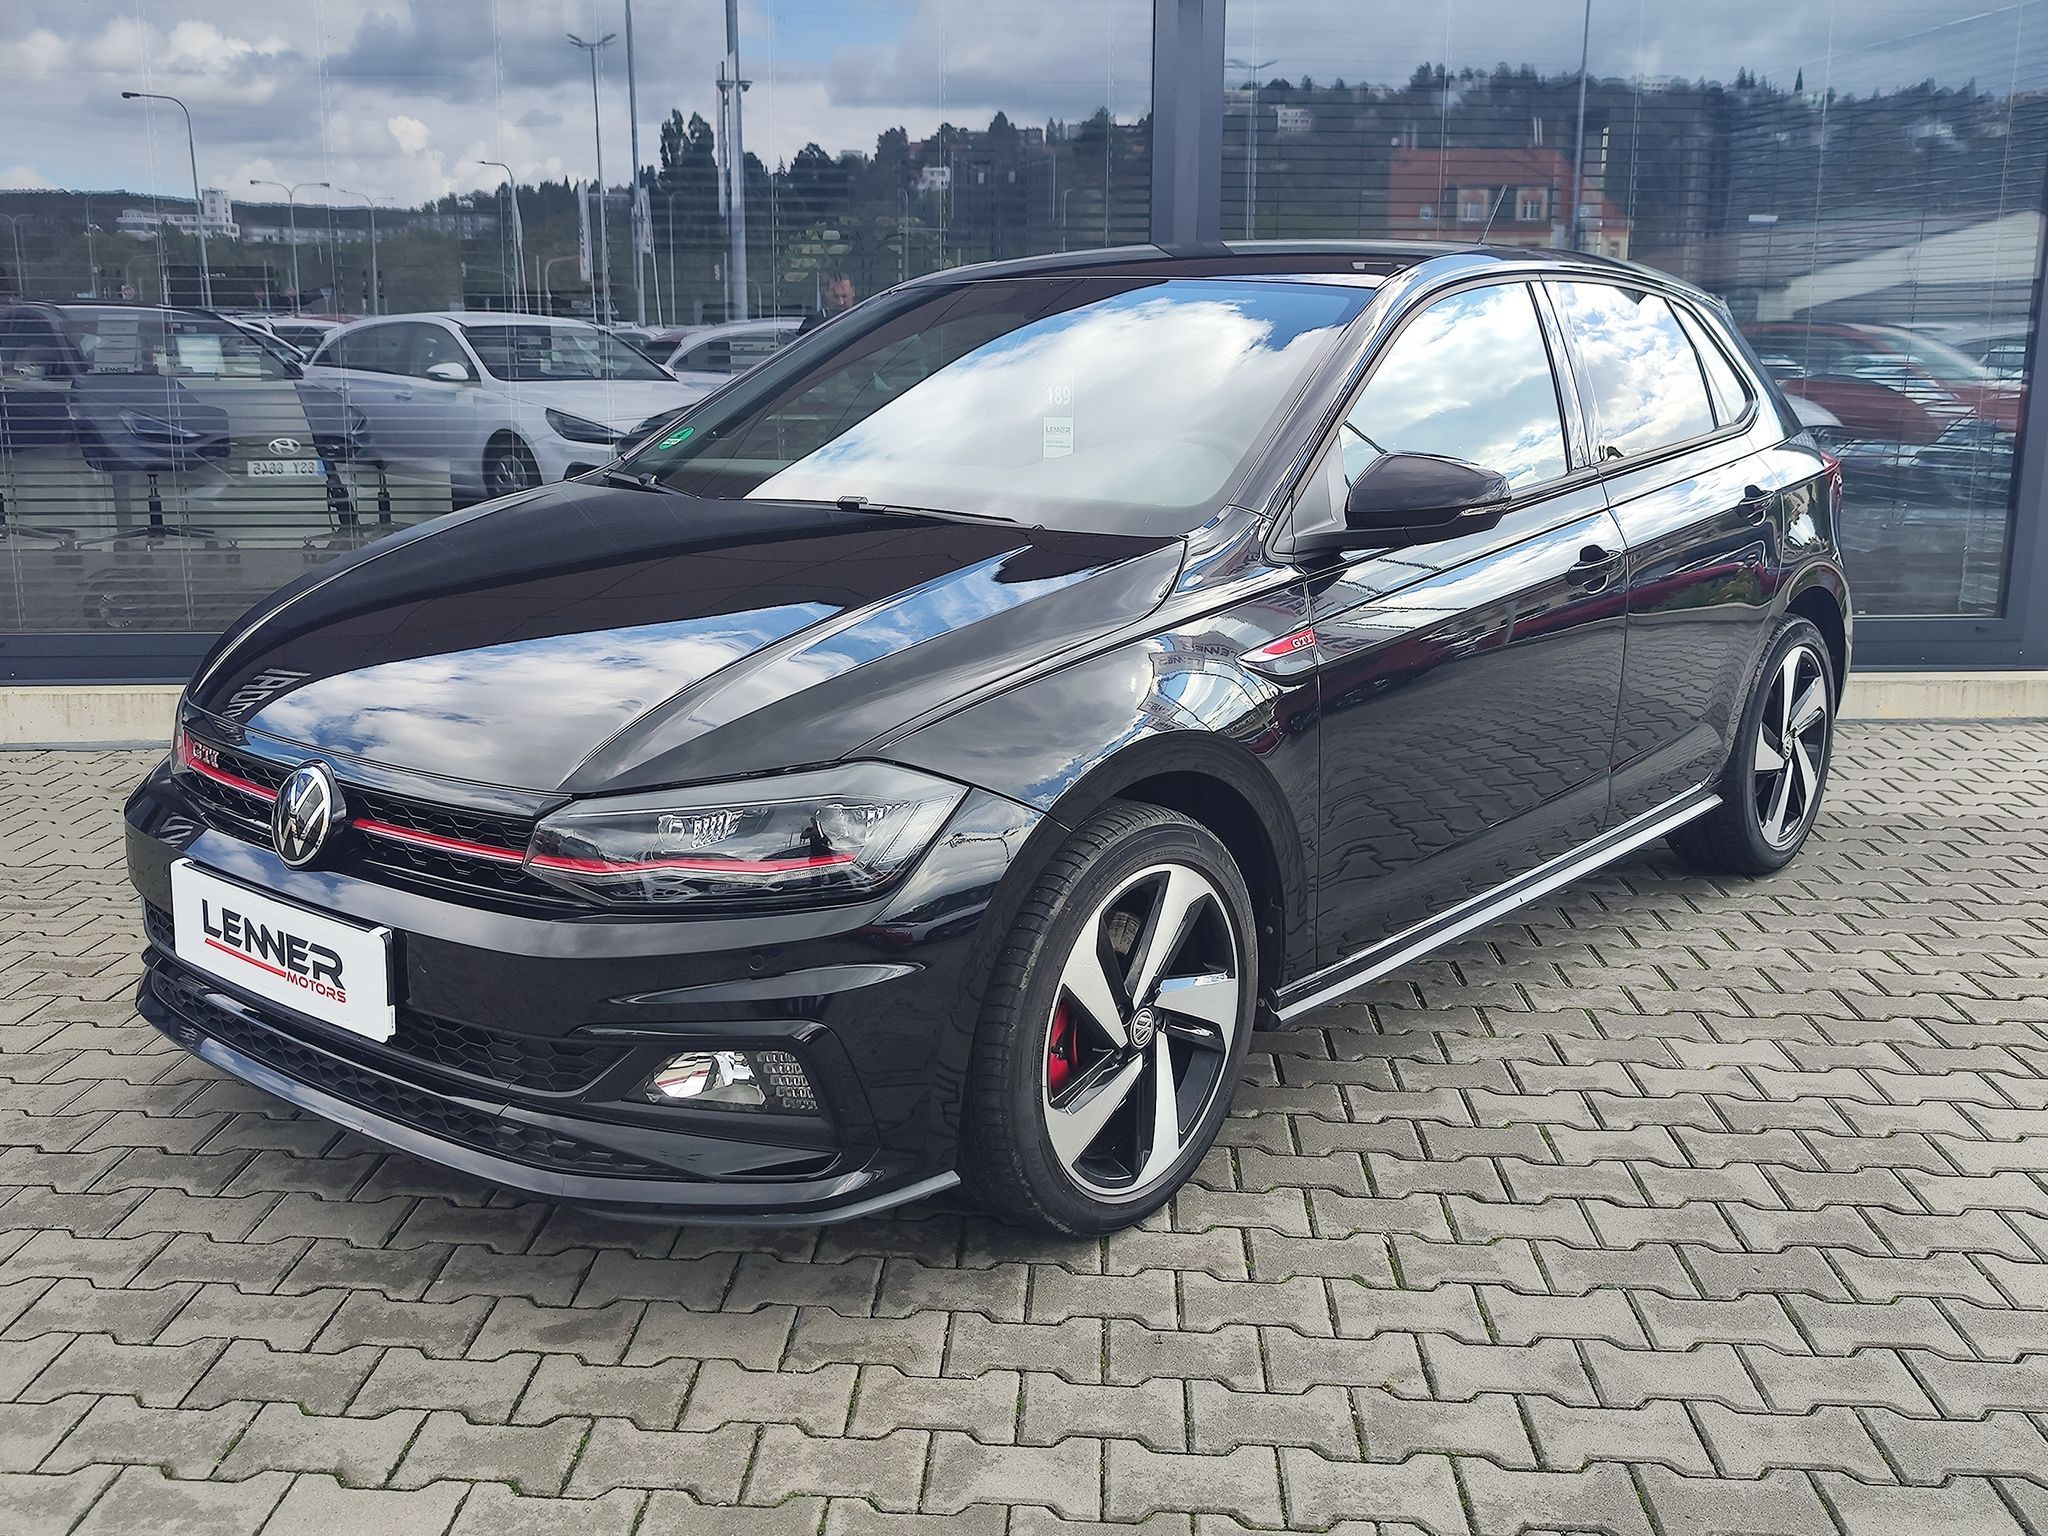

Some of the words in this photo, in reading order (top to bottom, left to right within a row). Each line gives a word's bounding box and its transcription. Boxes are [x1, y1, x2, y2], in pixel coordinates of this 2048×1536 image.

[100, 366, 129, 375] LENNER
[1046, 385, 1071, 405] 189
[1045, 426, 1071, 435] LENNER
[1292, 634, 1312, 648] GTI
[192, 741, 220, 768] GTI
[201, 898, 346, 991] LENNER
[286, 970, 347, 1004] MOTORS
